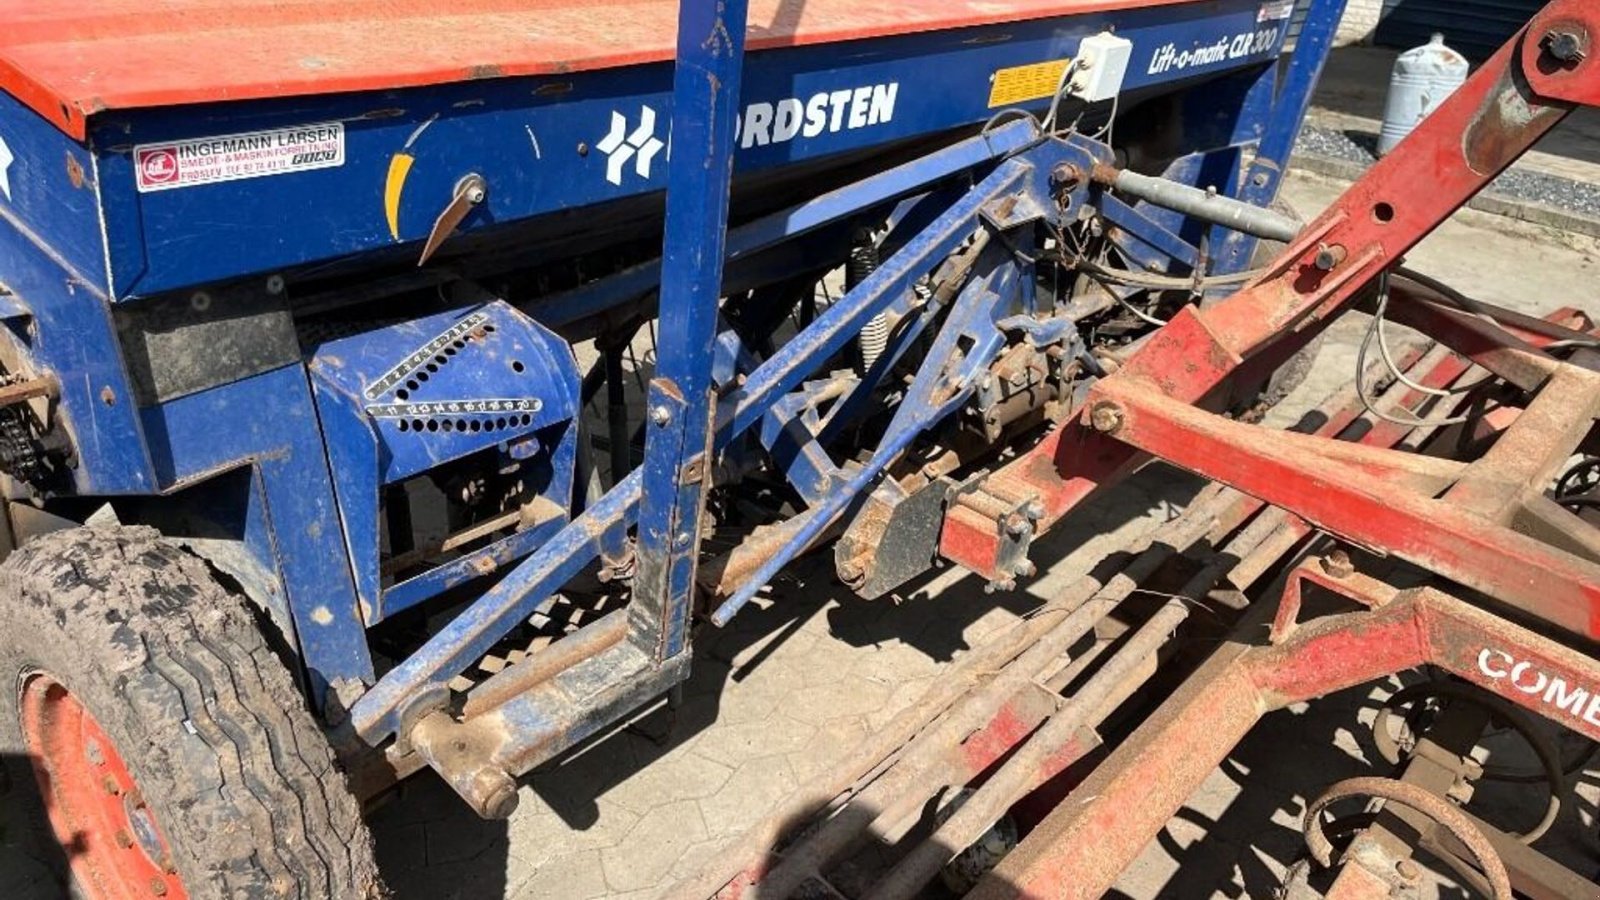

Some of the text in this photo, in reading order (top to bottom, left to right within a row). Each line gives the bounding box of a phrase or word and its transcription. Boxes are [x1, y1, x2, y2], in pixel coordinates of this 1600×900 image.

[1147, 36, 1229, 74] Lift-o-matic
[1251, 28, 1277, 54] 300
[179, 128, 338, 159] INGEMANN LARSEN
[666, 82, 898, 162] RDSTEN
